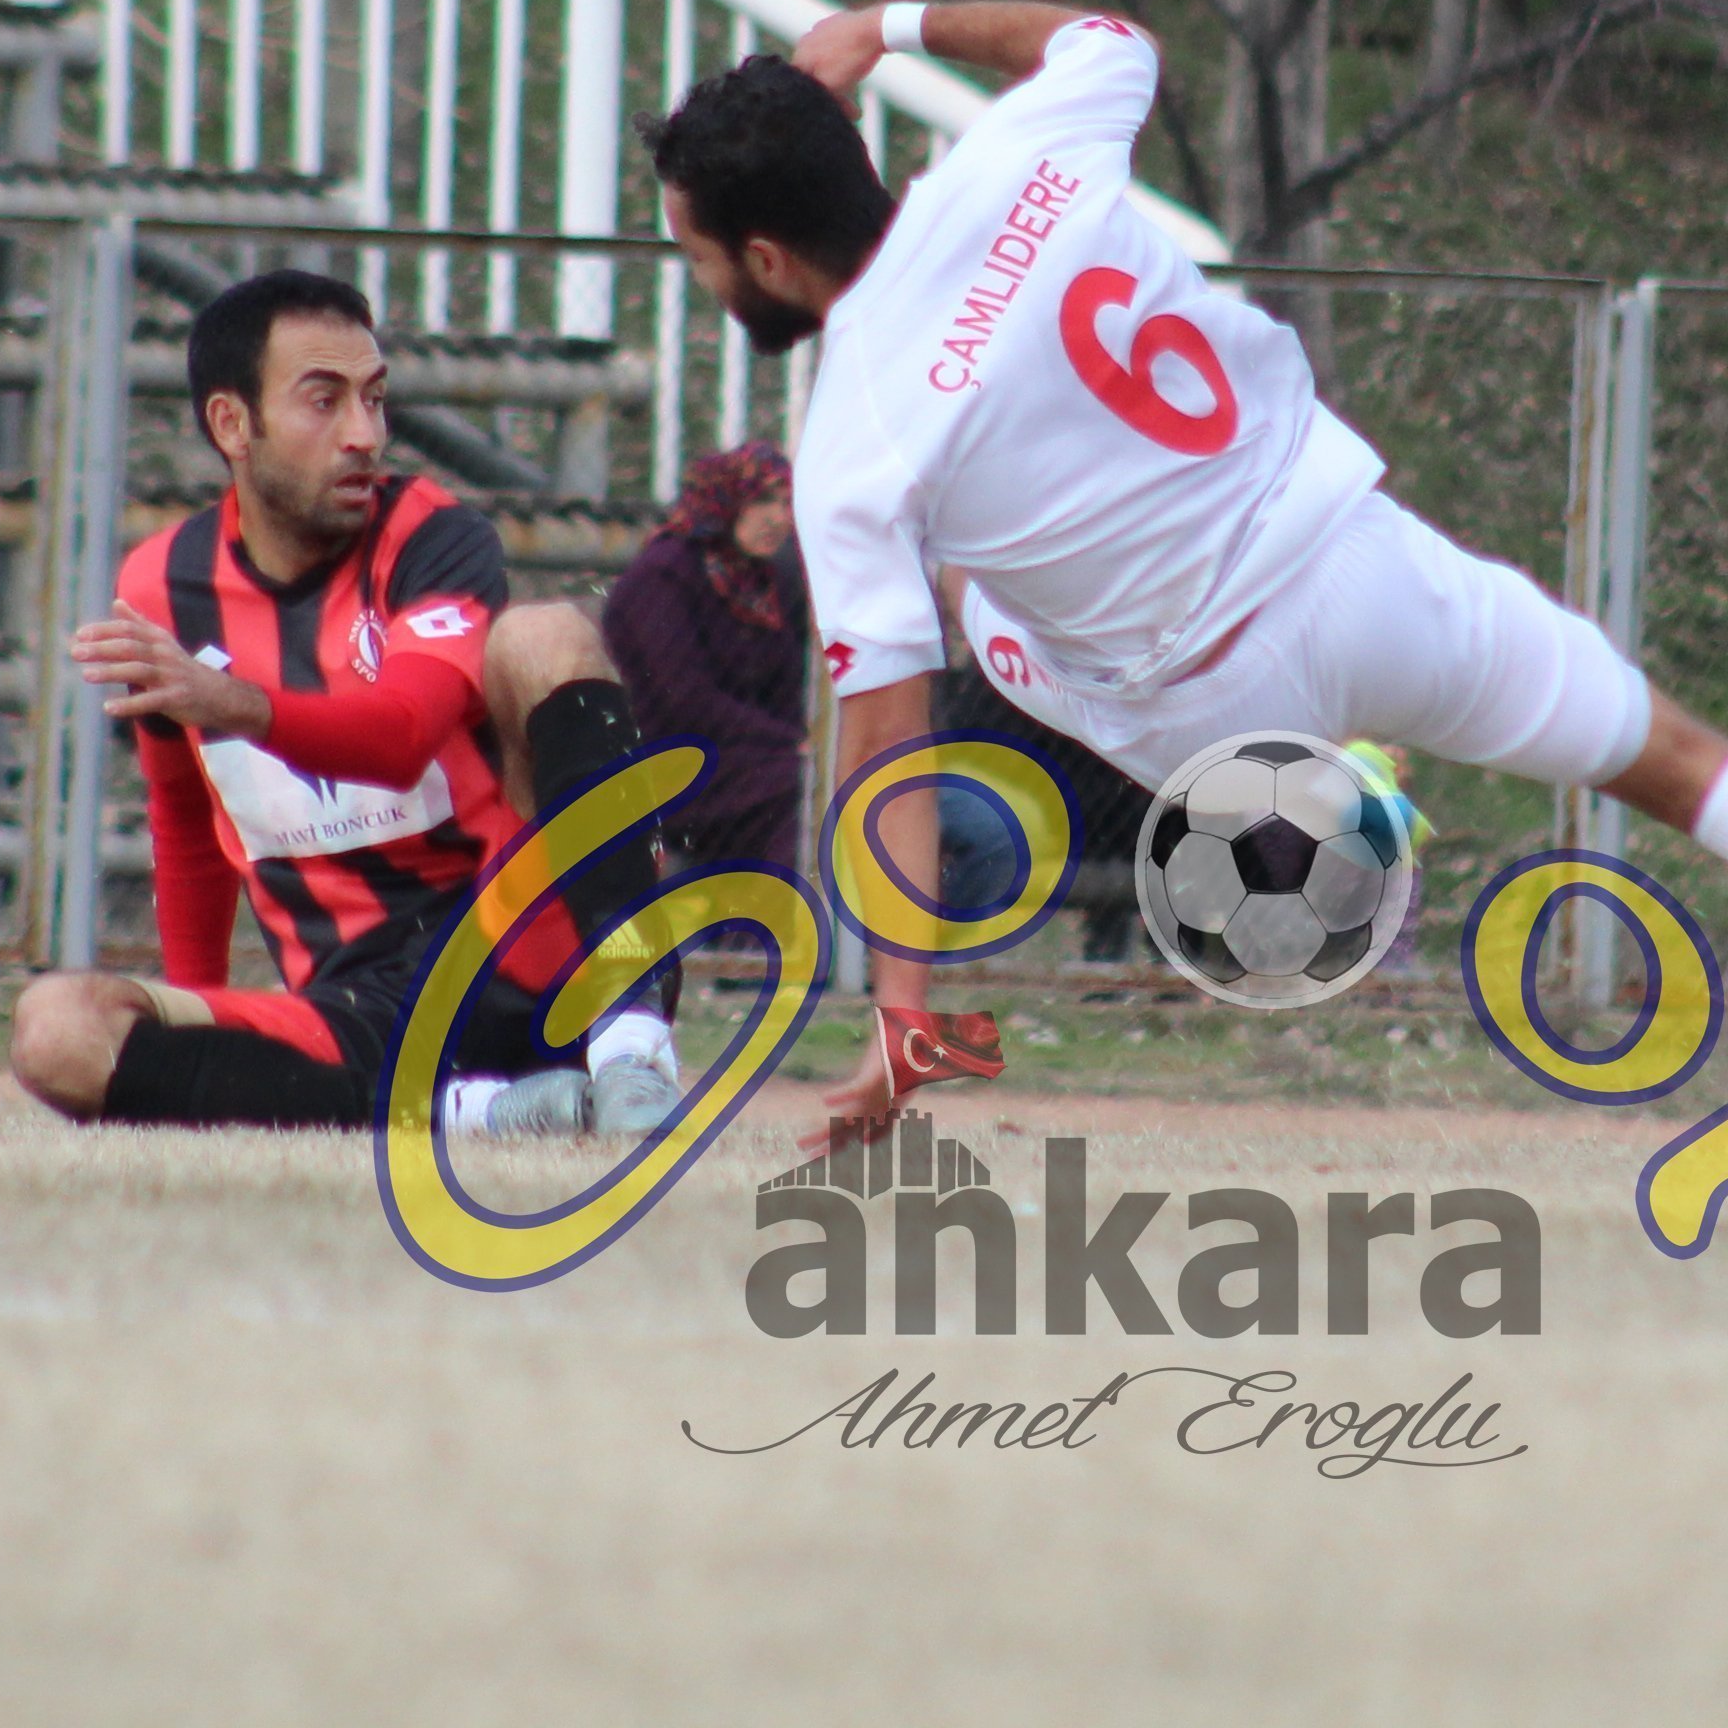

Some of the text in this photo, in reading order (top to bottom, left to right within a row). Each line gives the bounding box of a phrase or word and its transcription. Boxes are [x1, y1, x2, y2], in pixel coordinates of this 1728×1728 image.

[928, 159, 1082, 394] ÇAMLIDERE
[1059, 266, 1239, 457] 6
[322, 805, 408, 839] BONCUK
[597, 943, 651, 961] adidas
